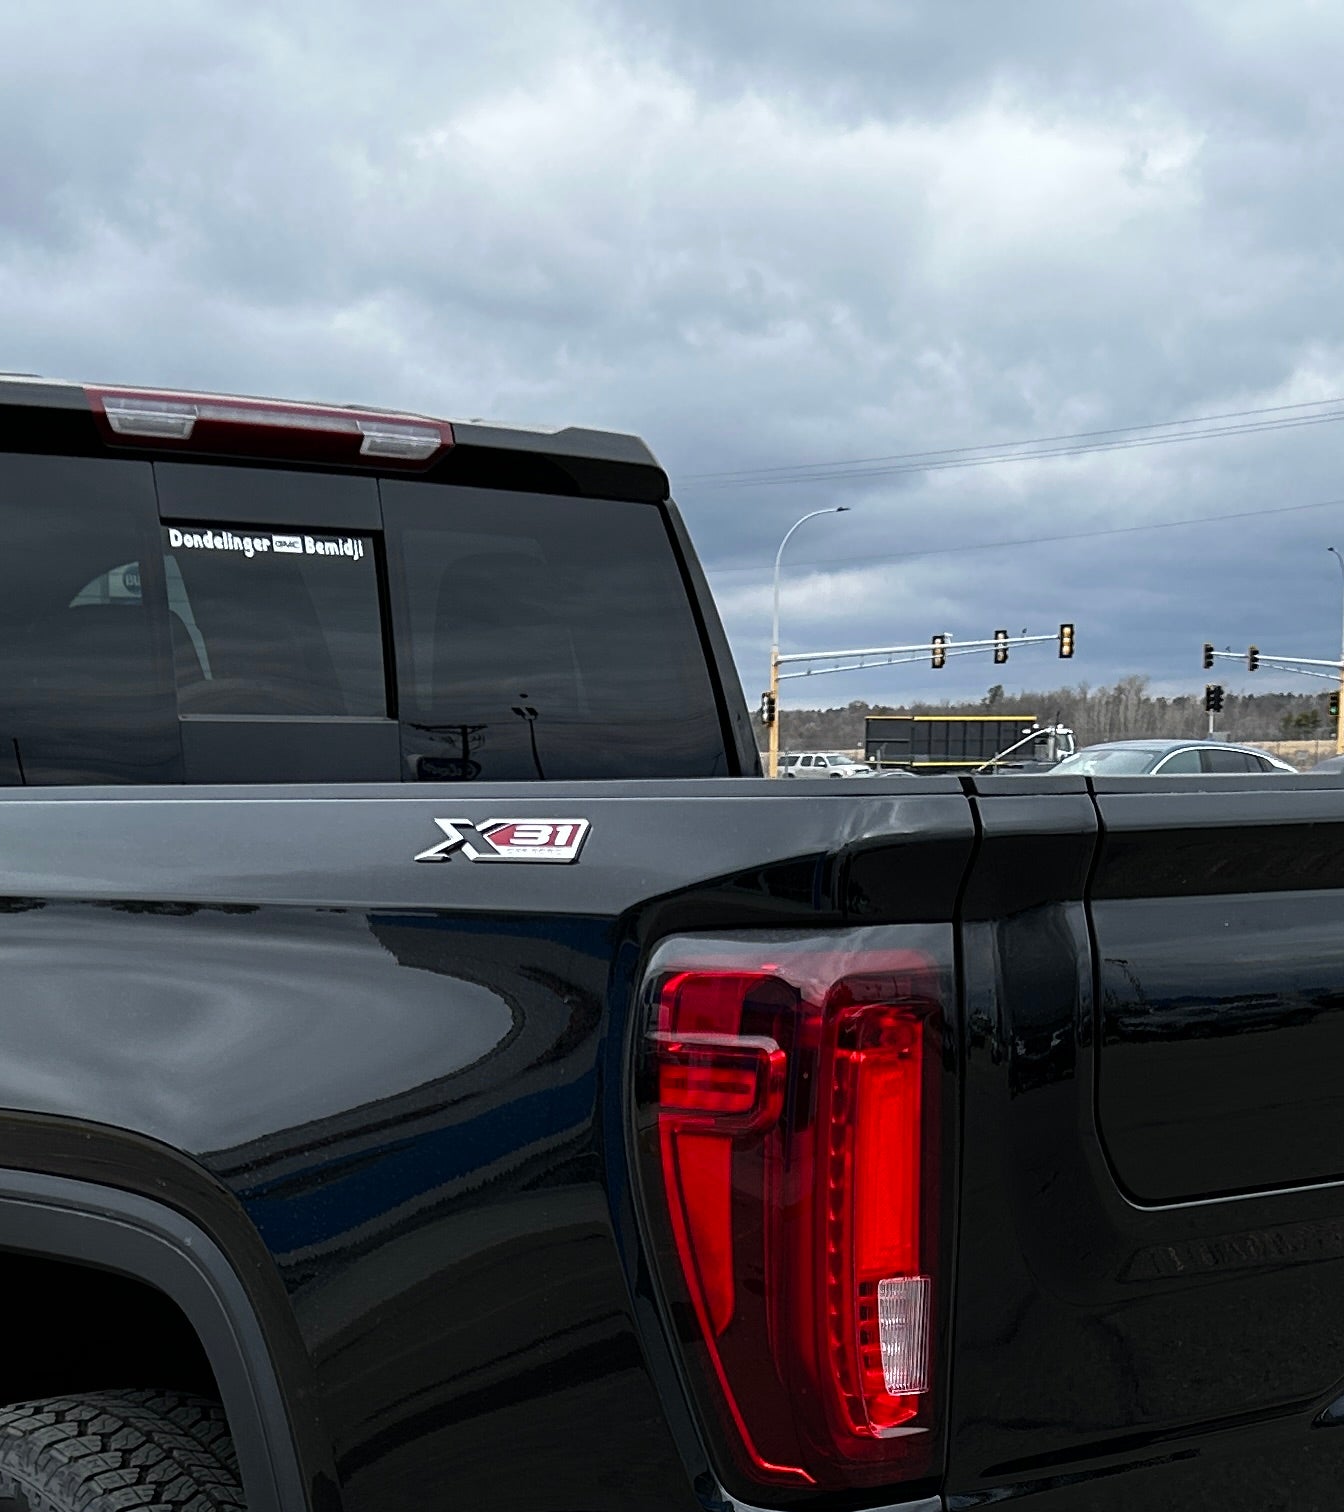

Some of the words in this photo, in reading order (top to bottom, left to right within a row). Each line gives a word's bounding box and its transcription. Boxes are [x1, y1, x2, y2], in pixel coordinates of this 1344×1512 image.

[168, 528, 271, 558] Dondelinger
[304, 535, 364, 561] Bemidji
[414, 817, 592, 864] X31
